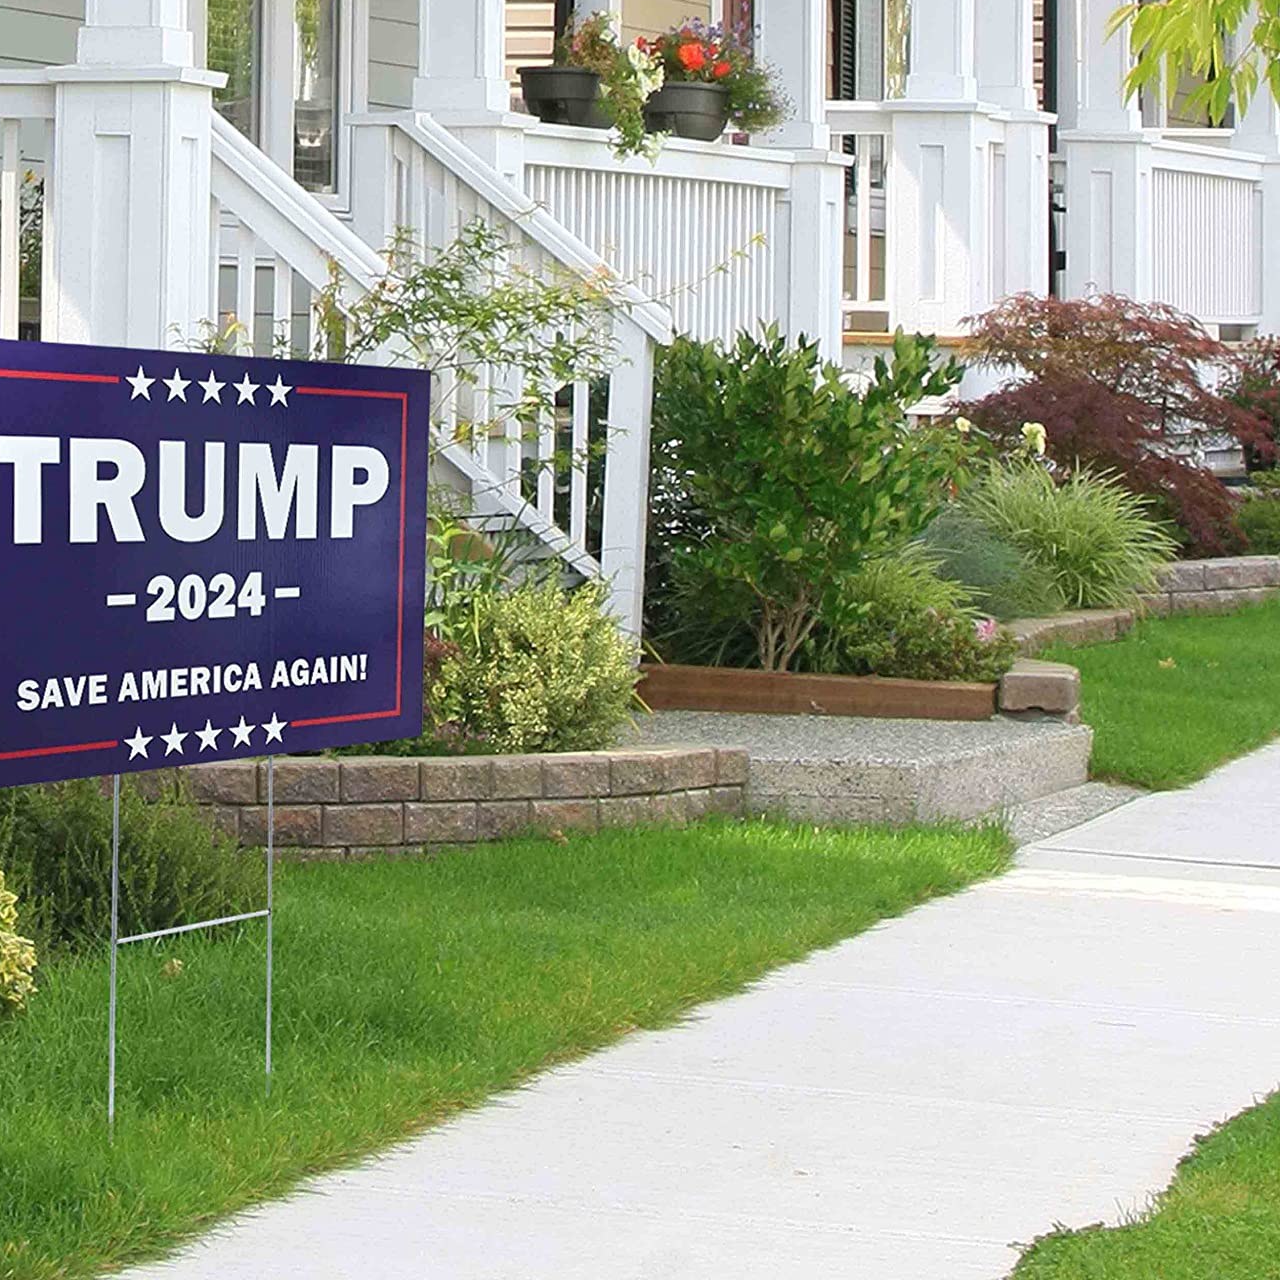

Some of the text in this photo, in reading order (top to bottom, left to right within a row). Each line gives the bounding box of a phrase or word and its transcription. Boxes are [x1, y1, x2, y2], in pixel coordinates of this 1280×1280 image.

[16, 654, 368, 711] SAVE AMERICA AGAIN!
